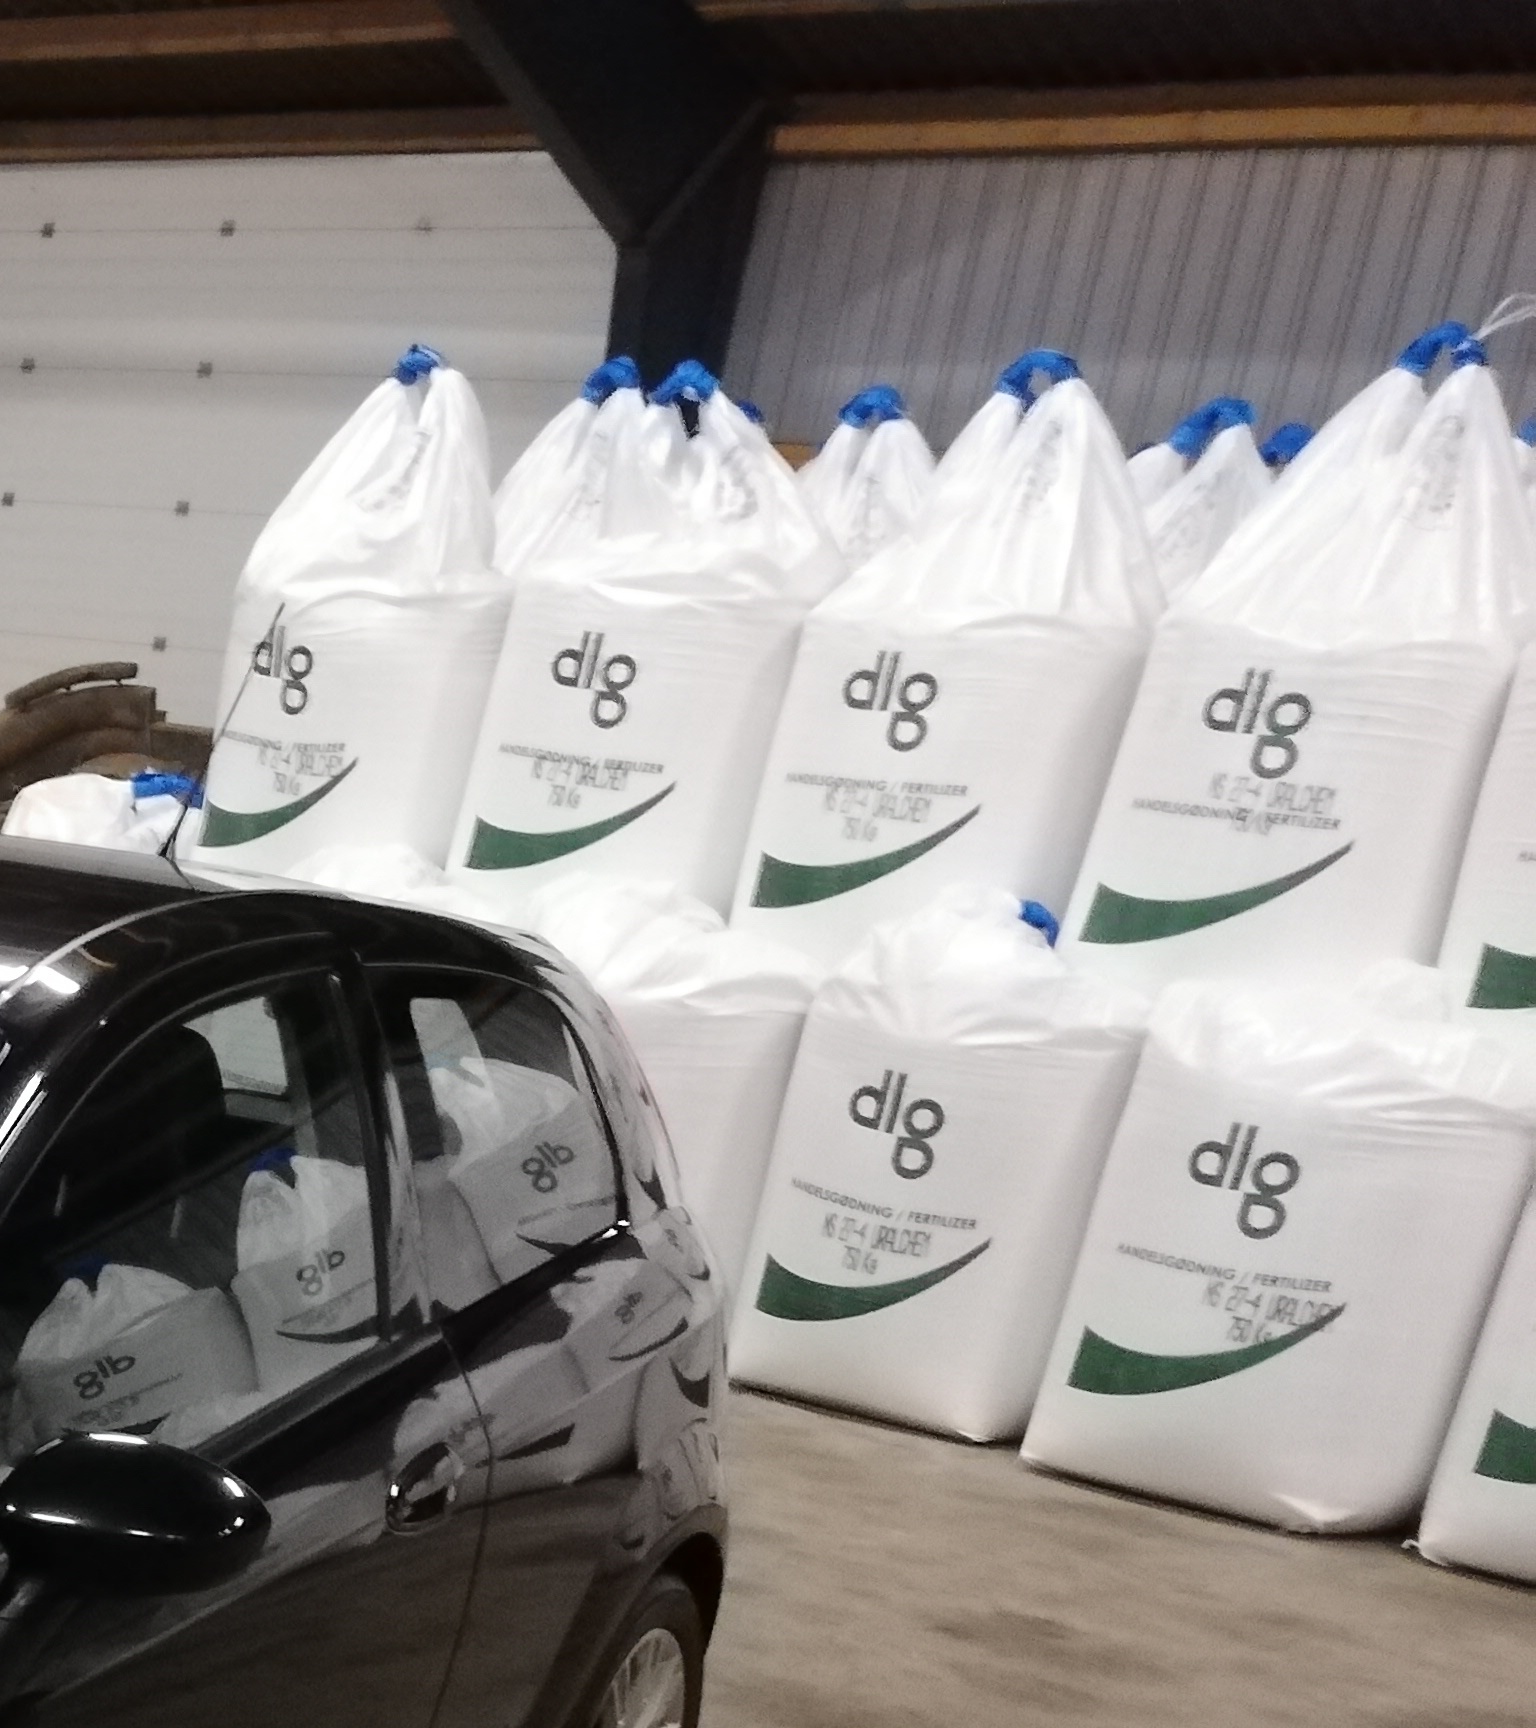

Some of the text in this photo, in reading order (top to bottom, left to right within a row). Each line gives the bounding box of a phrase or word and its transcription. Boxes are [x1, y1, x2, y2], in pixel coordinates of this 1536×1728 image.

[253, 625, 313, 715] dlg
[551, 631, 637, 728] dlg
[842, 652, 938, 752] dlg
[1202, 668, 1314, 779] dlg
[848, 1069, 945, 1180] dlg
[907, 1211, 977, 1230] FERTILIZER
[1188, 1122, 1301, 1240] dlg
[1252, 1272, 1332, 1292] FERTILIZER
